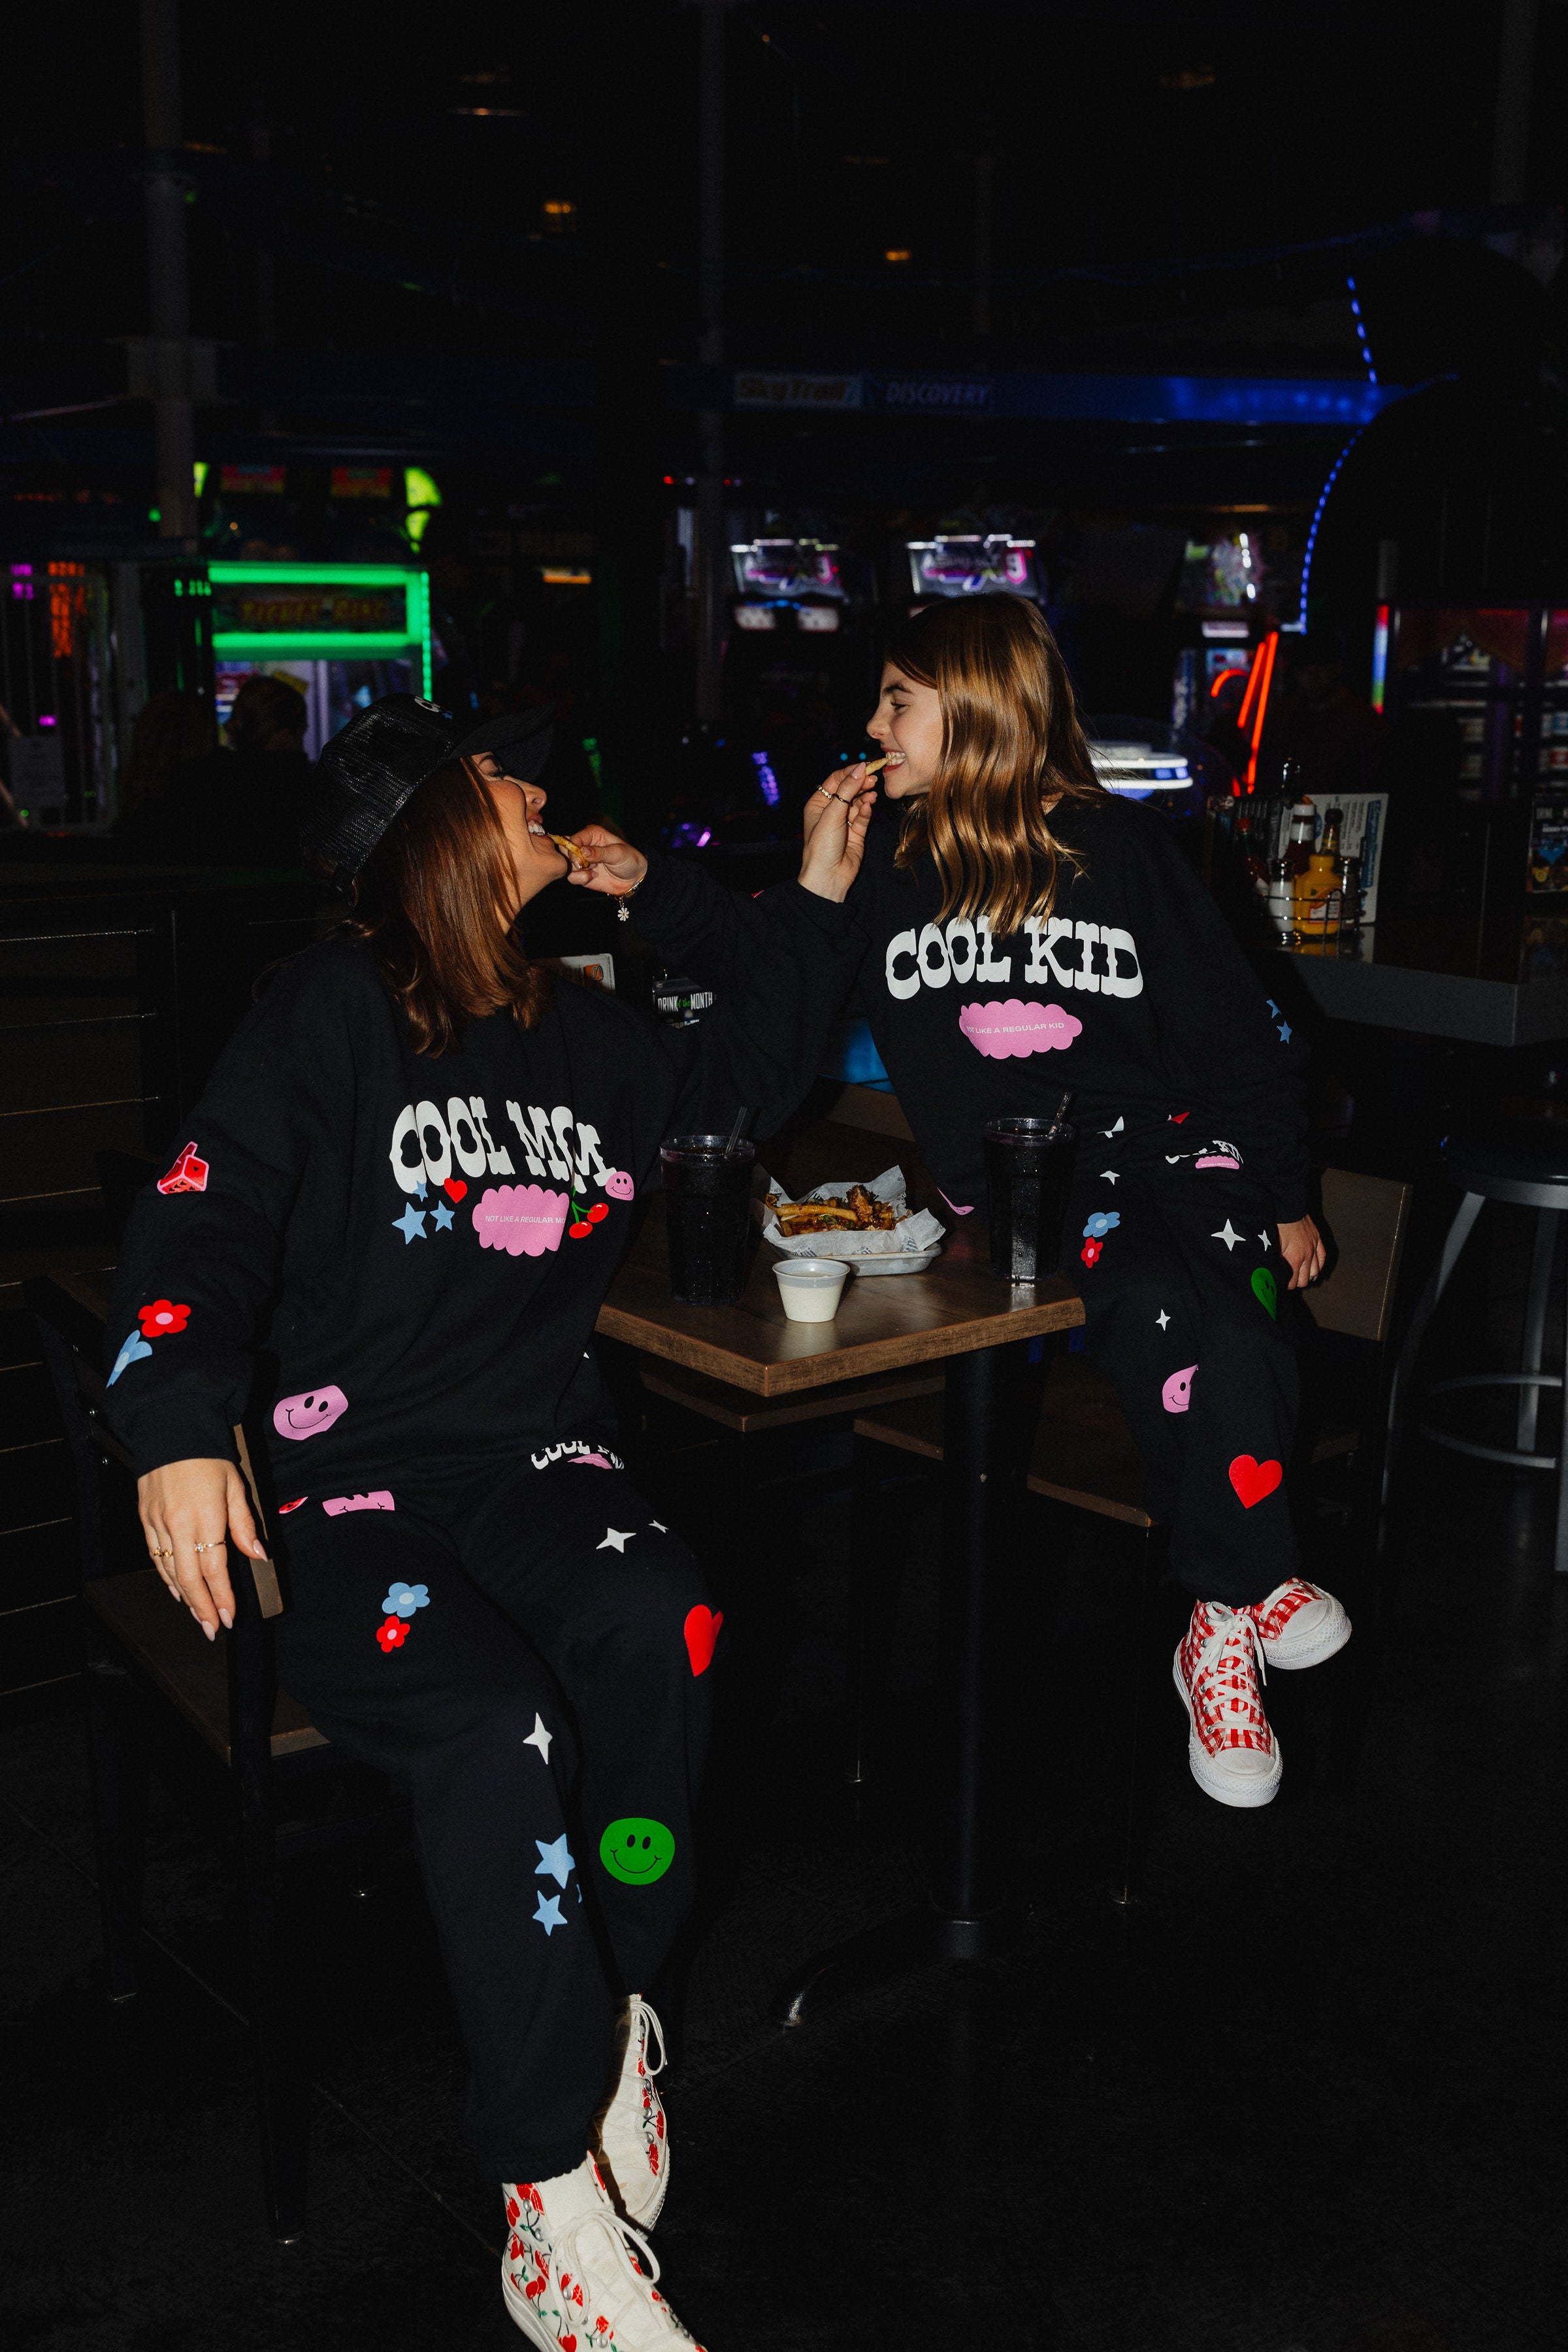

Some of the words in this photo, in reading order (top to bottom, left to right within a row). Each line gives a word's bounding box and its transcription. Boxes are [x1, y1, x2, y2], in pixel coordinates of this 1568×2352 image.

[885, 382, 989, 405] DISCOVERY
[885, 915, 1011, 1000] COOL
[1024, 915, 1143, 998] KID
[657, 995, 679, 1013] DRINK
[690, 992, 713, 1010] MONTH
[1003, 1024, 1047, 1033] REGULAR
[389, 1096, 515, 1194] COOL
